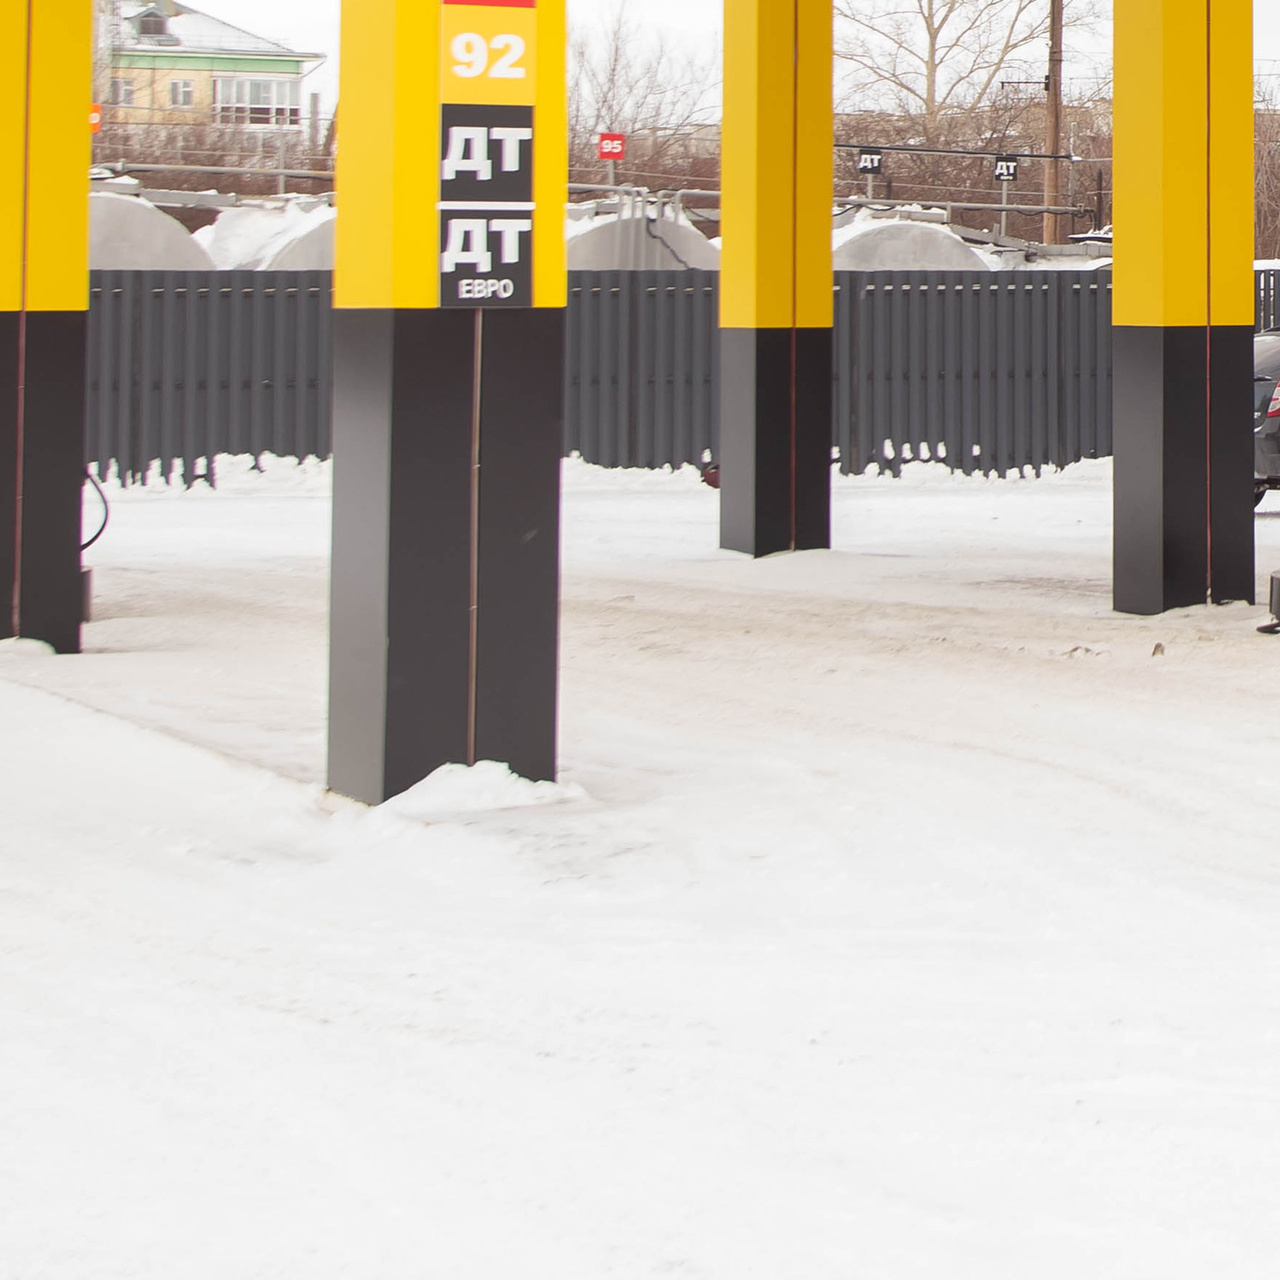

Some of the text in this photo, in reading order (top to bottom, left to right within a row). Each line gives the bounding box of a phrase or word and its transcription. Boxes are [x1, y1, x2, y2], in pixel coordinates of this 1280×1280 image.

[451, 32, 526, 79] 92
[442, 126, 532, 181] ДТ
[602, 140, 622, 153] 95
[859, 154, 882, 169] ДТ
[995, 161, 1017, 175] ДТ
[442, 218, 532, 273] ДТ
[458, 278, 514, 300] ЕВРО
